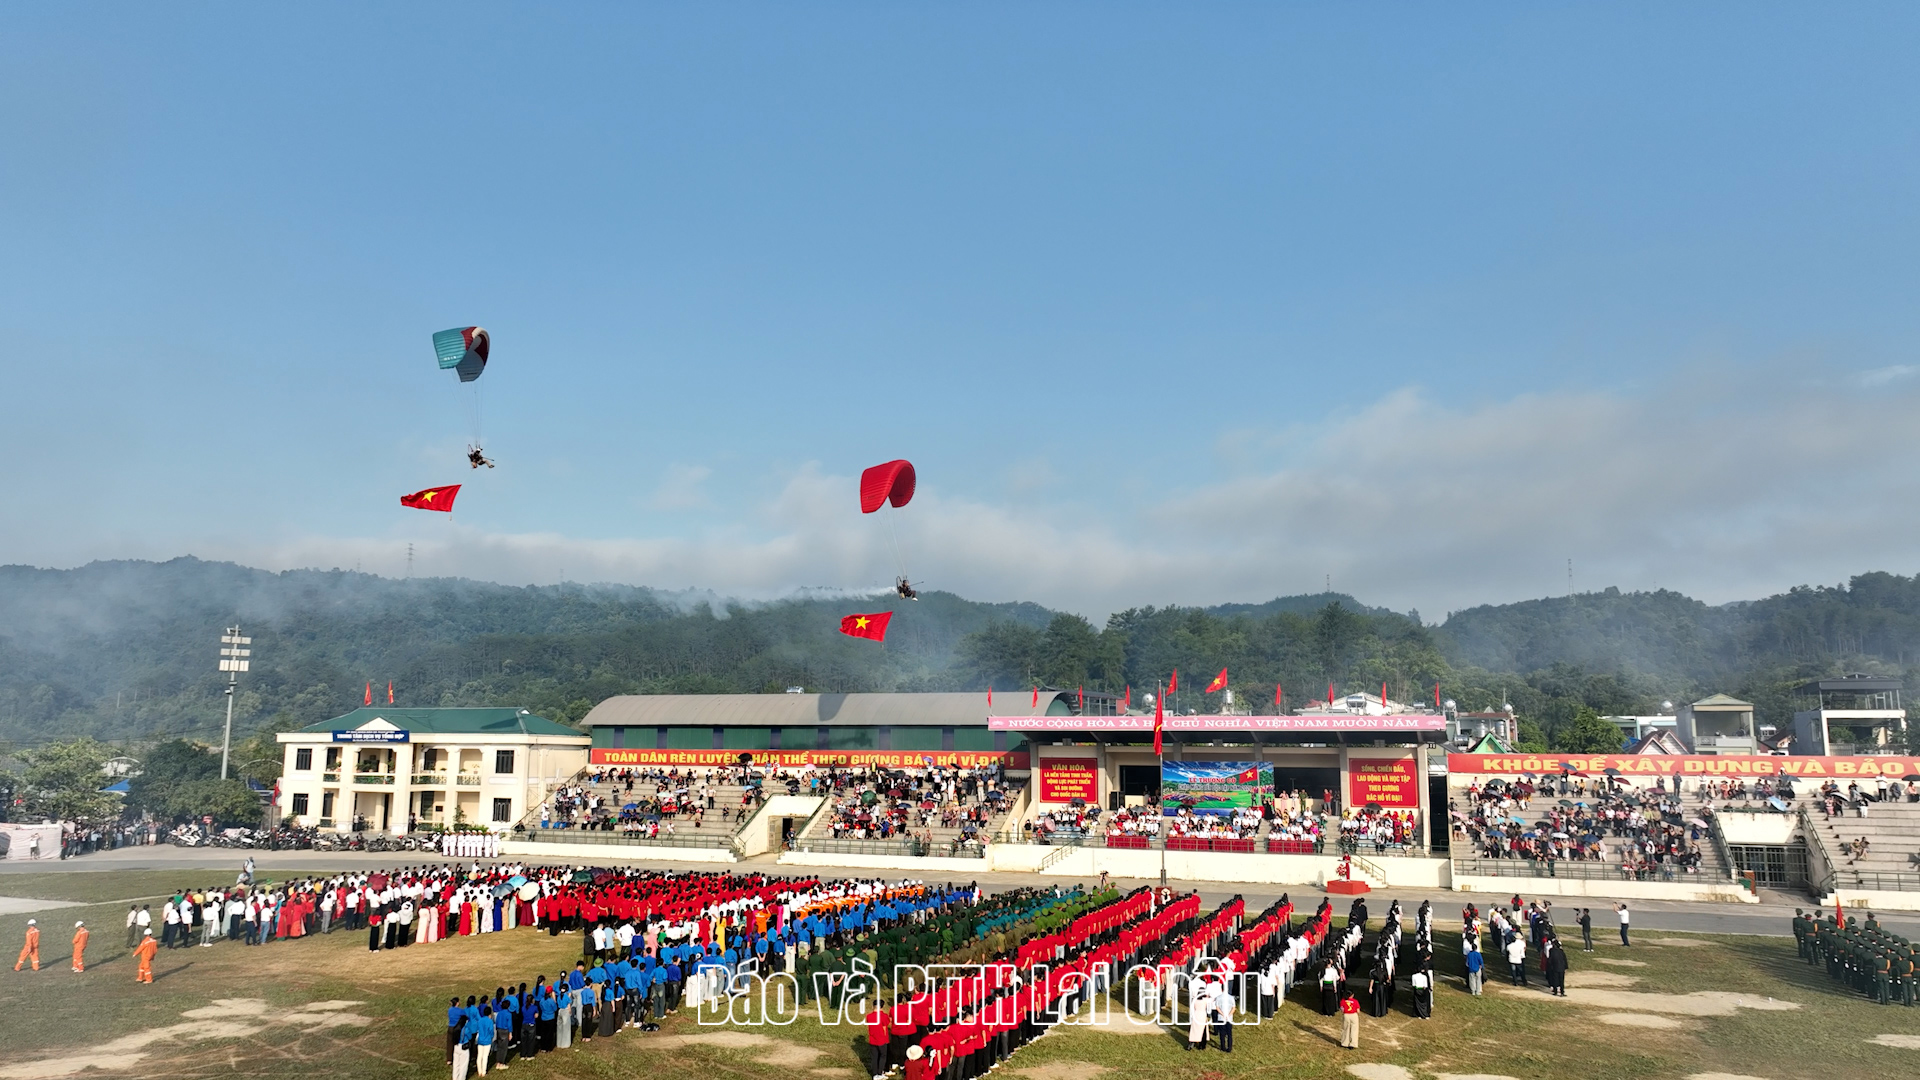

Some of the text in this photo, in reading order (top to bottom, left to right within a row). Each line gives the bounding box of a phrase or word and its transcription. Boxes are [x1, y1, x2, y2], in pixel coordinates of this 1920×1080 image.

[1008, 717, 1419, 729] NƯỚC CỘNG HÒA XÃ HI CHỦ NGHĨA VIỆT NAM MUÔN NĂM
[604, 752, 638, 763] TOÀN
[640, 752, 668, 763] DÂN
[670, 751, 698, 763] RÈN
[699, 752, 740, 765] LUYỆN
[751, 752, 780, 764] HÂN
[783, 751, 809, 764] THỂ
[811, 754, 847, 765] THEO
[850, 753, 900, 765] GƯƠNG
[937, 752, 958, 766] HỒ
[961, 754, 977, 767] VĨ
[1362, 764, 1377, 772] SỐNG,
[1377, 764, 1393, 772] CHIẾN
[1482, 756, 1560, 771] KHỎE
[1564, 755, 1608, 772] ĐỂ
[1615, 758, 1675, 772] XÂY
[1684, 759, 1774, 775] DỰNG
[1781, 759, 1826, 774] VÀ
[1834, 758, 1905, 774] BẢO
[1367, 774, 1381, 783] ĐỘNG
[1389, 775, 1400, 783] HỌC
[1401, 775, 1411, 783] TẬP
[1366, 793, 1377, 801] BÁC
[1378, 793, 1385, 801] HỒ
